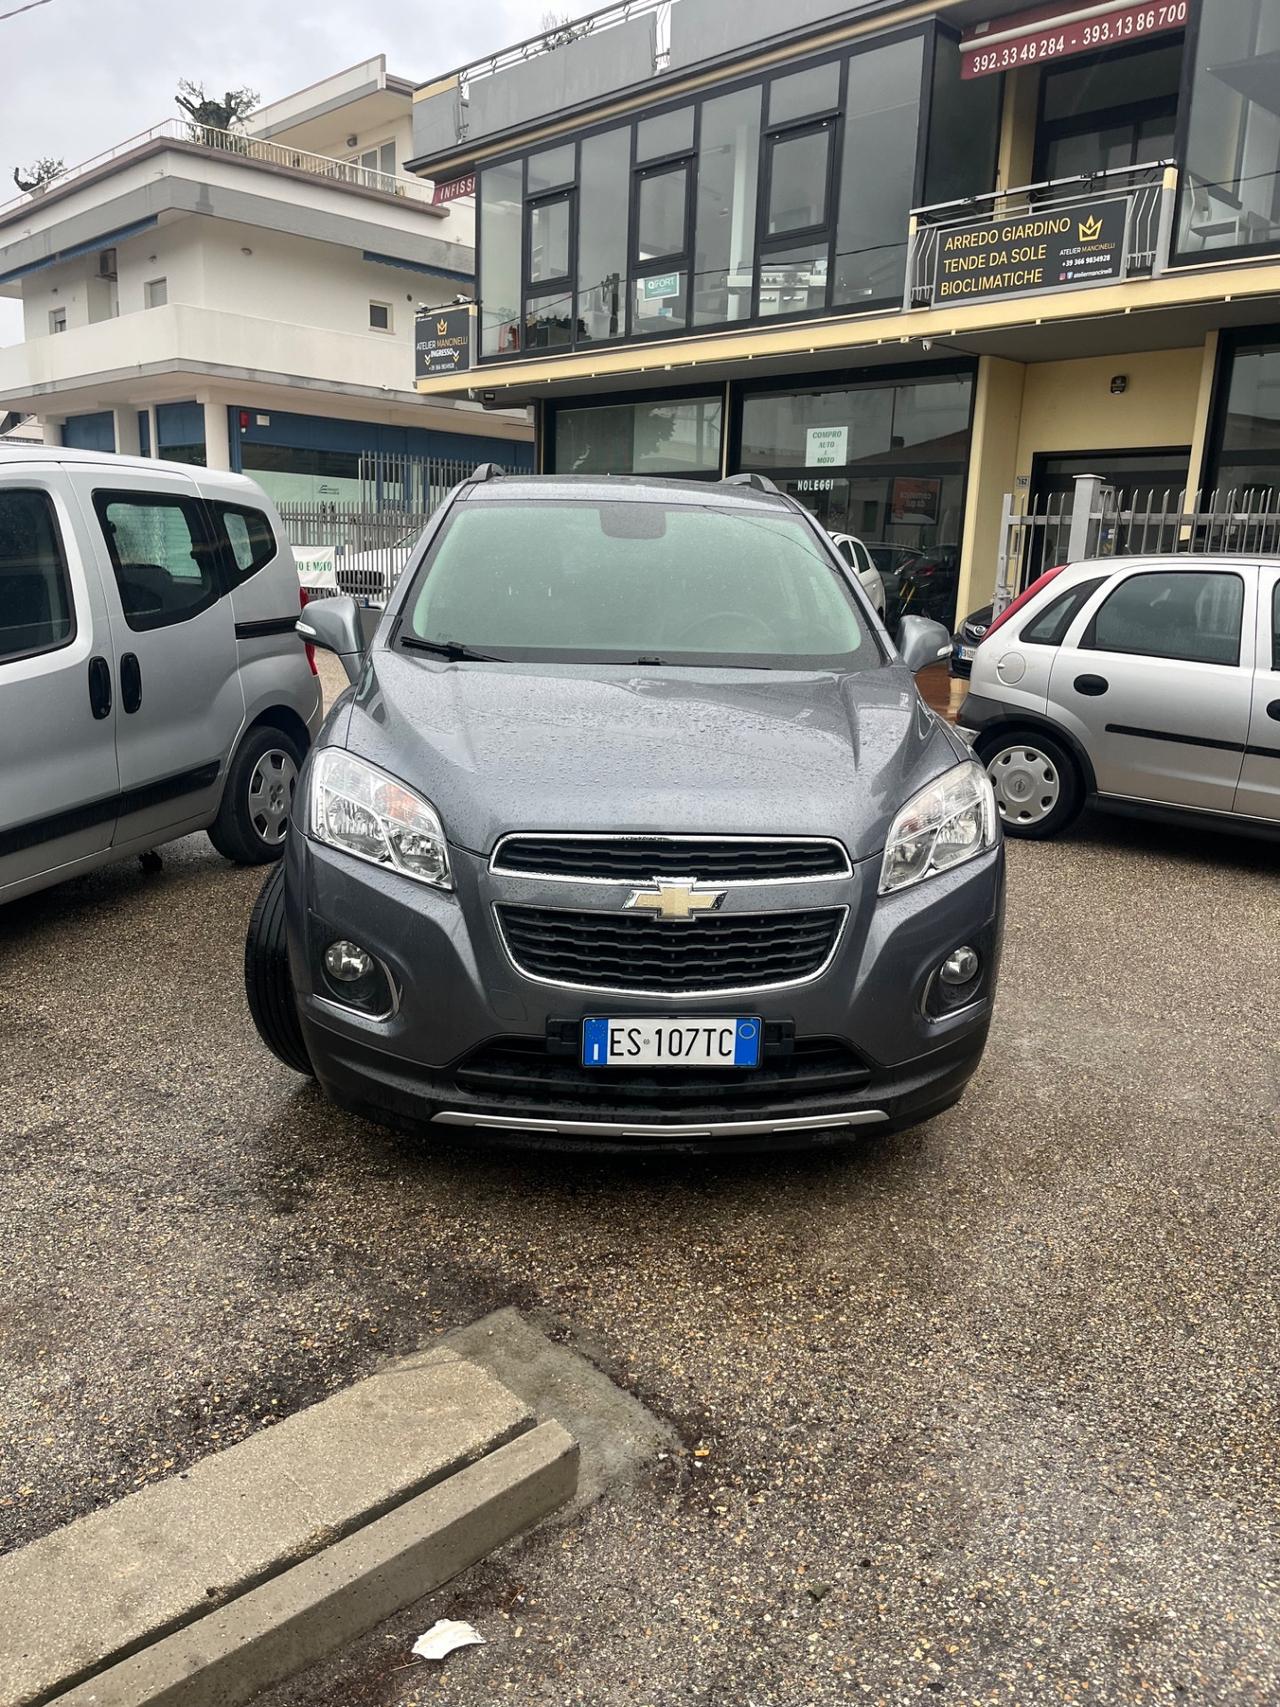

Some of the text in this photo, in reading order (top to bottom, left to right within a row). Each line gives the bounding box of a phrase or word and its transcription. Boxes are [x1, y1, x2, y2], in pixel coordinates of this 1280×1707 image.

[440, 177, 476, 200] INFISSI
[944, 217, 1071, 252] ARREDO GIARDINO
[1060, 242, 1116, 256] ATELIER MANCINELLI
[943, 244, 1047, 273] TENDE DA SOLE
[940, 268, 1044, 296] BIOCLIMATICHE
[416, 336, 468, 351] ATELIER MANCINELLI
[430, 348, 454, 358] INGRESSO
[812, 430, 842, 439] COMPRO
[817, 456, 835, 464] MOTO
[797, 479, 834, 491] NOLEGGI
[610, 1028, 642, 1057] ES
[655, 1028, 733, 1057] 107TC
